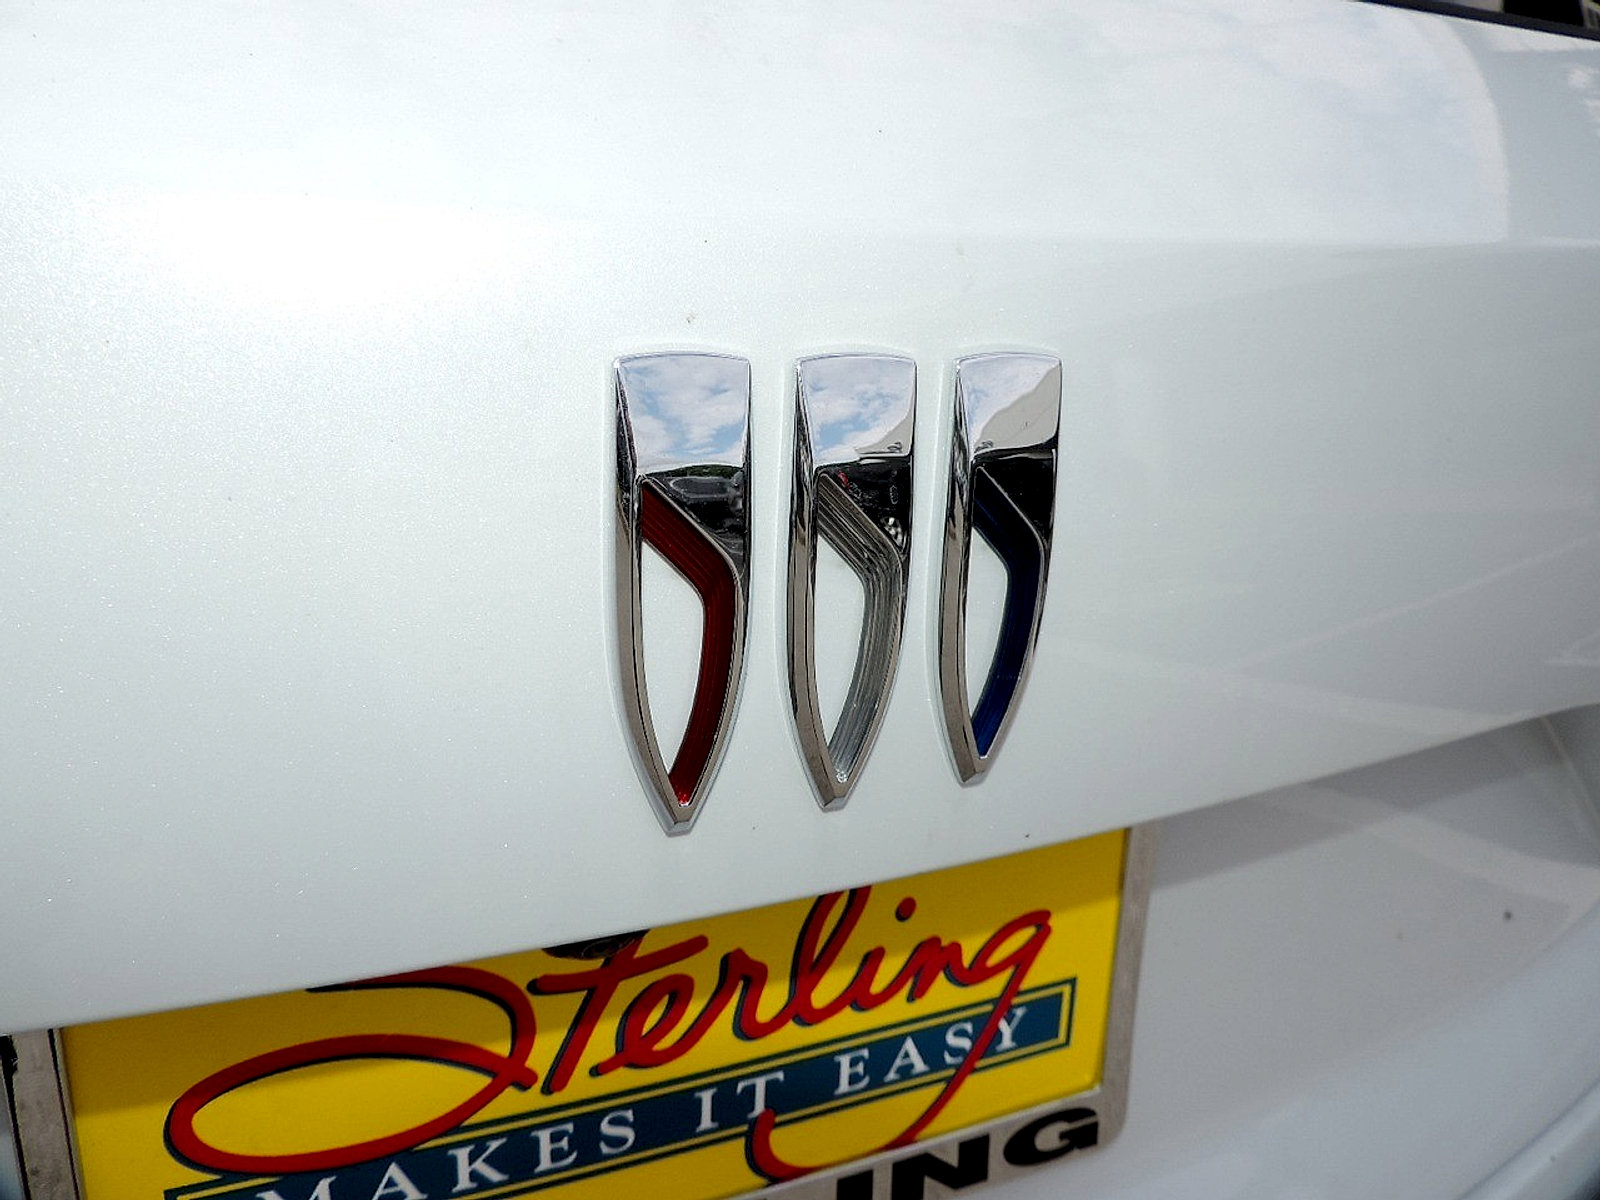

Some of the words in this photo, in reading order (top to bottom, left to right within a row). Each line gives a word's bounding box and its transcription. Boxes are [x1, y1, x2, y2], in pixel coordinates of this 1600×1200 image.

[164, 886, 1052, 1186] Sterling
[694, 1070, 785, 1133] IT
[833, 1005, 1027, 1096] EASY
